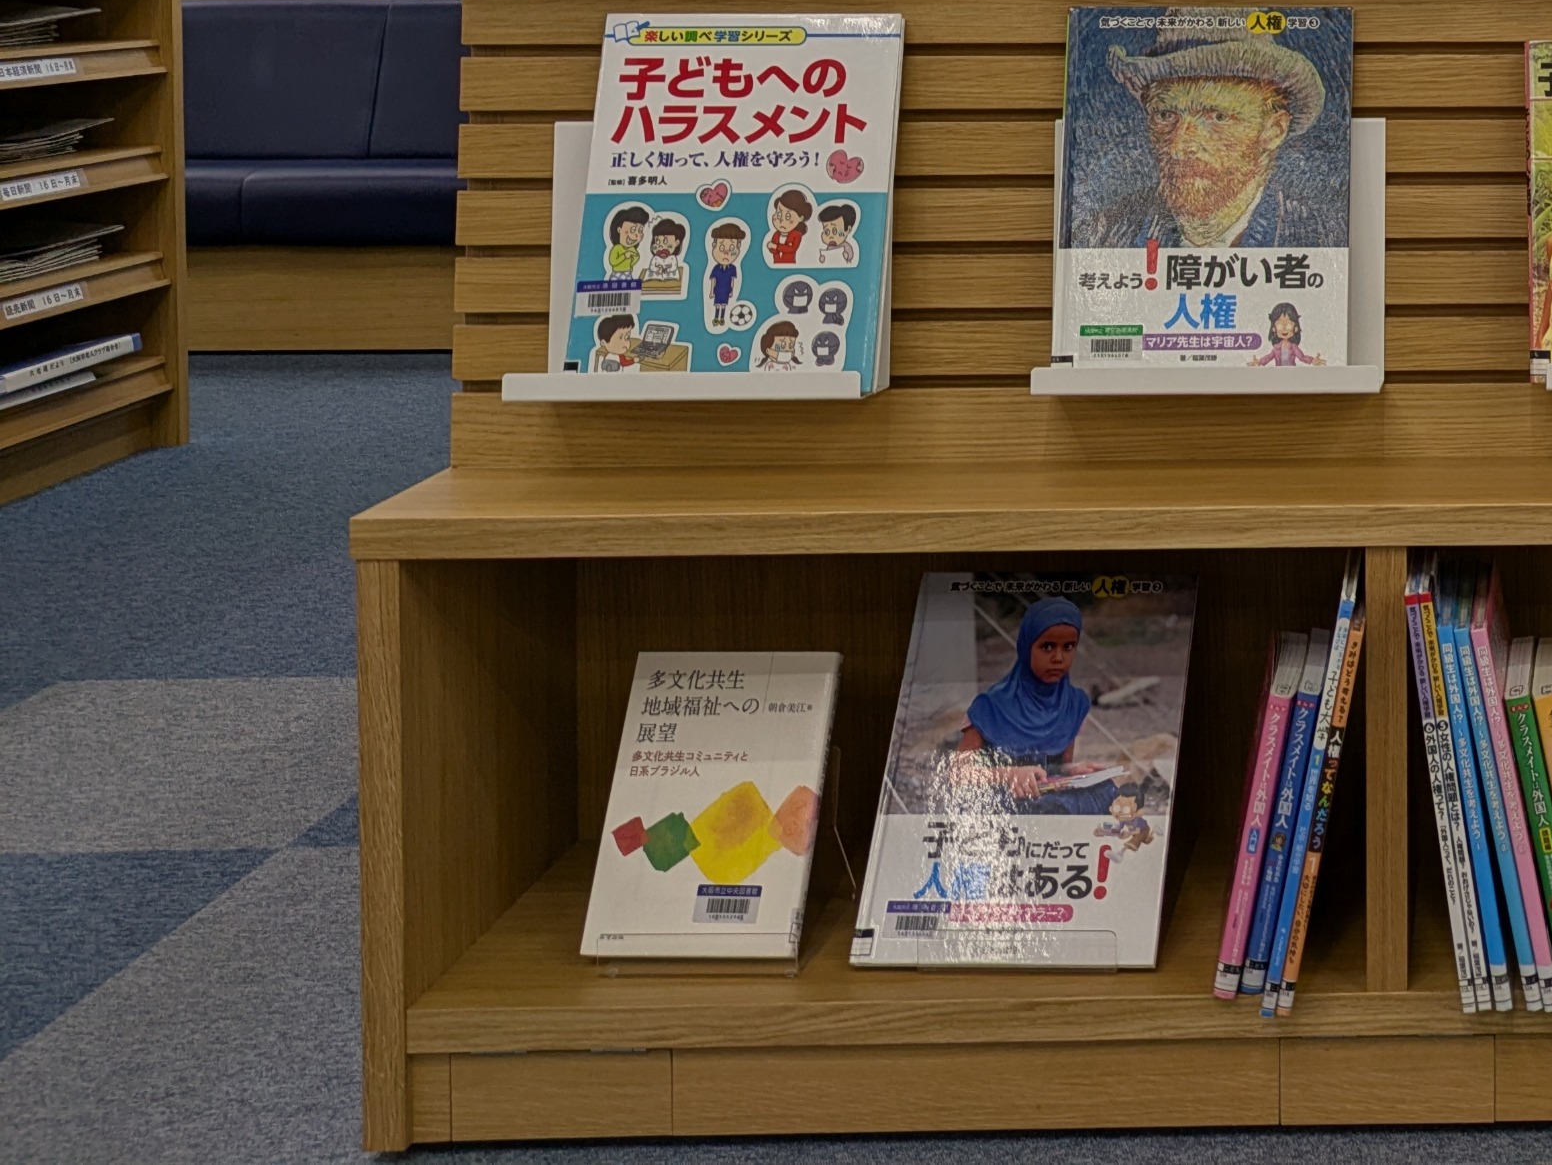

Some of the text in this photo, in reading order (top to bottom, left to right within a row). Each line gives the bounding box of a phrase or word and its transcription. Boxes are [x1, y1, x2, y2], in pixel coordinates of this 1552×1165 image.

[1099, 14, 1308, 31] 気づくことで 未来がかわる 新しい 人権 学習
[643, 29, 793, 44] 楽しい調べ学習シリーズ
[618, 57, 847, 101] 子どもへの
[610, 103, 868, 144] ハラスメント
[609, 150, 820, 169] 正しく知って、人権を守ろう!
[2, 181, 34, 199] 毎日新聞
[627, 175, 668, 186] 喜多明人
[1165, 253, 1324, 291] 障がい者の
[4, 297, 37, 316] 読売新聞
[1164, 293, 1238, 330] 人権
[1145, 334, 1254, 350] マリア先生は宇宙人?
[1093, 577, 1151, 597] 人権 学習
[646, 669, 746, 691] 多文化共生
[1337, 641, 1359, 723] きみはどう考える?
[640, 695, 806, 717] 地域福祉への 朝倉美江
[1316, 670, 1340, 741] 子ども大学
[635, 721, 678, 744] 展望
[631, 750, 749, 763] 多文化共生コミュニティと
[1275, 708, 1310, 828] クラスメイトは外国人
[629, 765, 701, 778] 日系ブラジル人
[1250, 711, 1286, 828] クラスメイトは外国人
[1425, 734, 1444, 821] 外国人の人権って?
[1516, 713, 1550, 827] クラスメイトは外国人
[1308, 729, 1343, 850] 人権ってなんだろう
[1439, 732, 1461, 832] 女性の人権問題とは?
